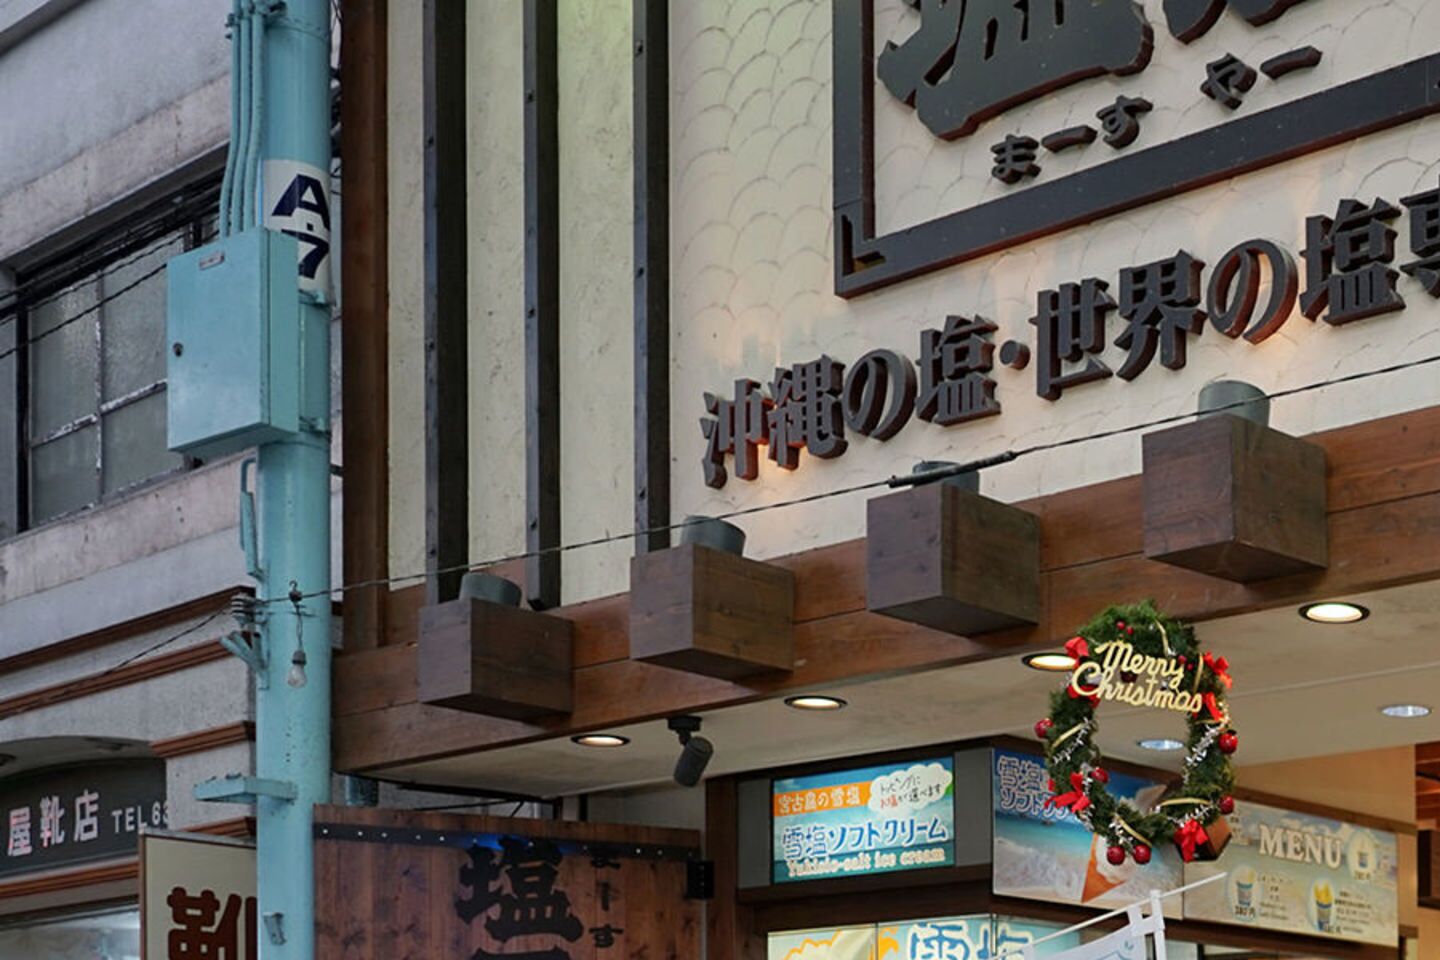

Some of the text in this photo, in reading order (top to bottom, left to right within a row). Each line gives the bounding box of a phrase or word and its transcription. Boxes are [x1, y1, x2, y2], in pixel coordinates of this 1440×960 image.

[1072, 661, 1203, 713] Christmas
[1095, 639, 1185, 688] Merry
[7, 790, 99, 857] 屋靴店
[111, 805, 147, 834] TEL
[783, 817, 947, 858] 雪塩ソフトクリーム
[1258, 823, 1343, 869] MENU
